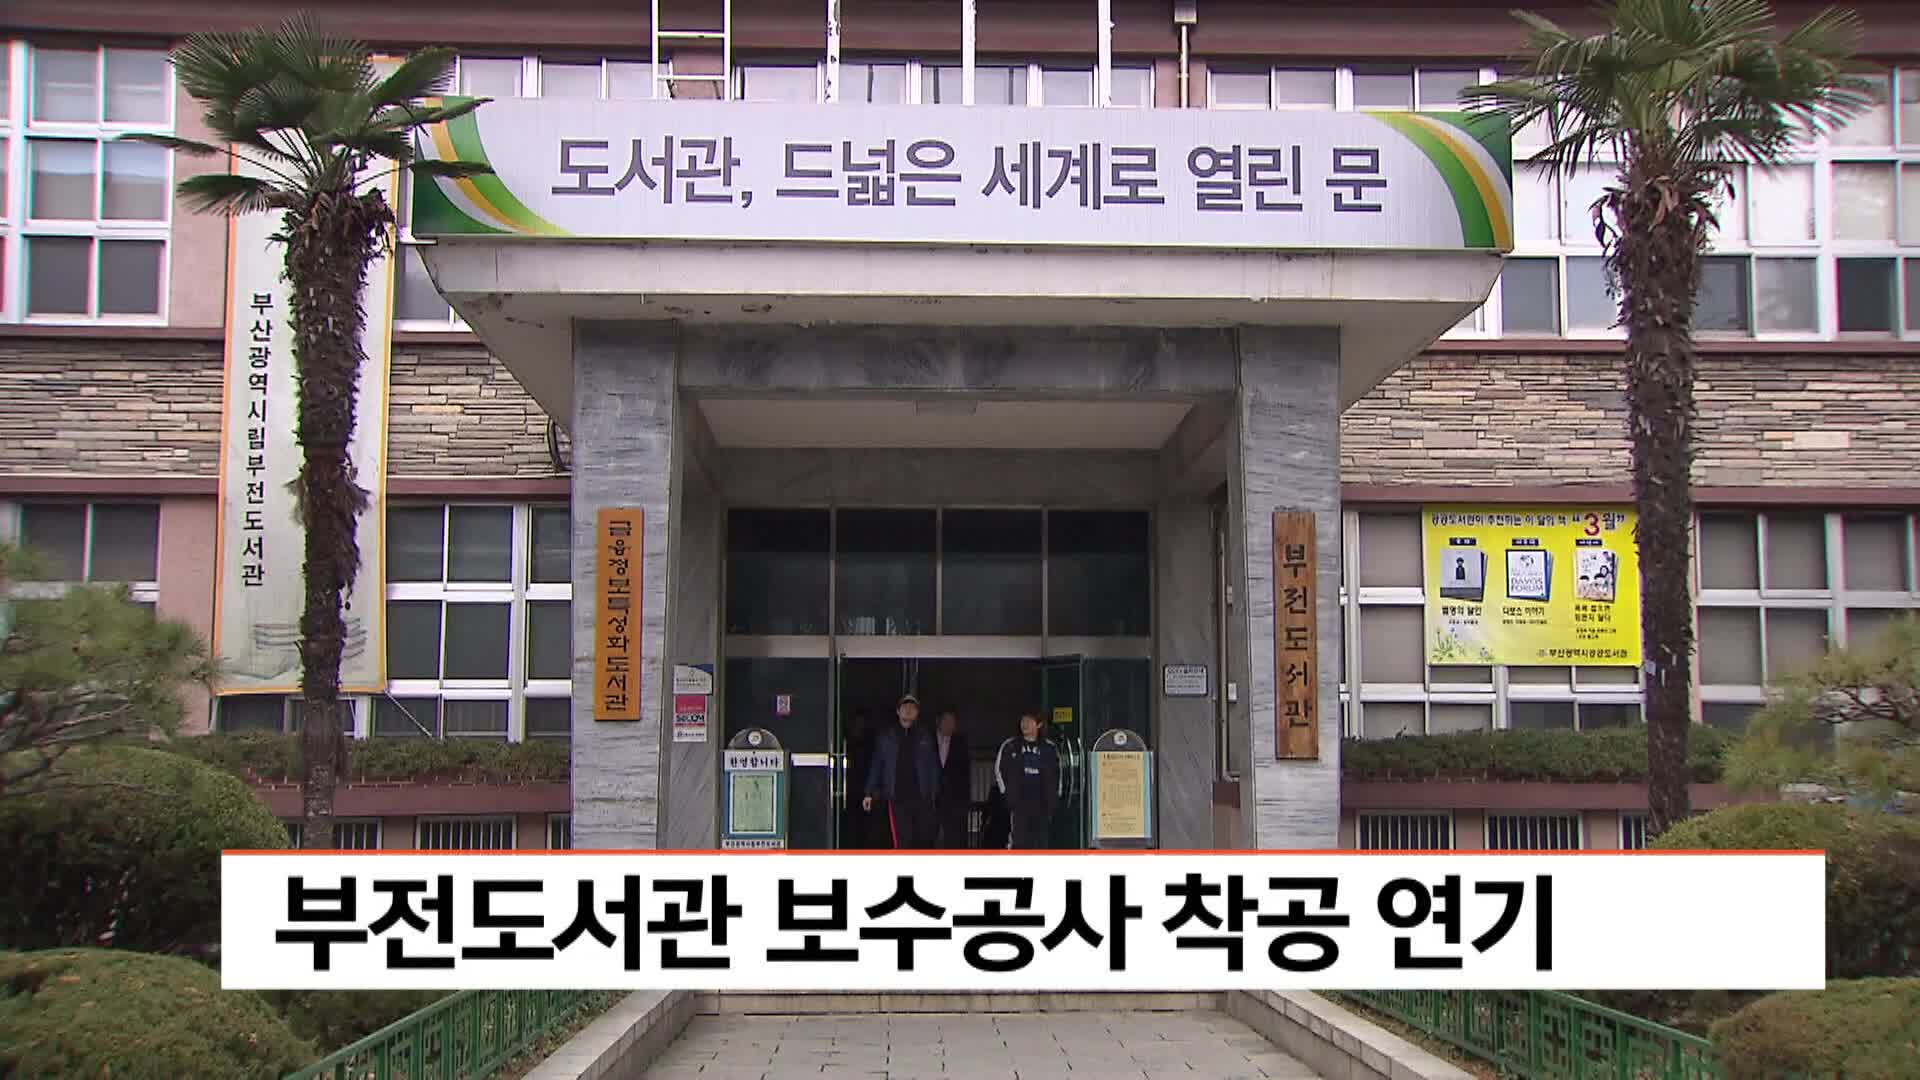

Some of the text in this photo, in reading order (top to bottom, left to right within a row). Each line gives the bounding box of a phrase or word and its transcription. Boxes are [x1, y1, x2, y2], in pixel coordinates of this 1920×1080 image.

[551, 135, 1388, 212] 도서관, 드넓은 세계로 열린 문
[242, 293, 274, 587] 부산광역시립부전도서관
[1525, 514, 1534, 525] 이
[605, 520, 632, 712] 금융정보특성화도서관
[1283, 543, 1312, 729] 부전도서관
[1511, 584, 1543, 592] FORUM
